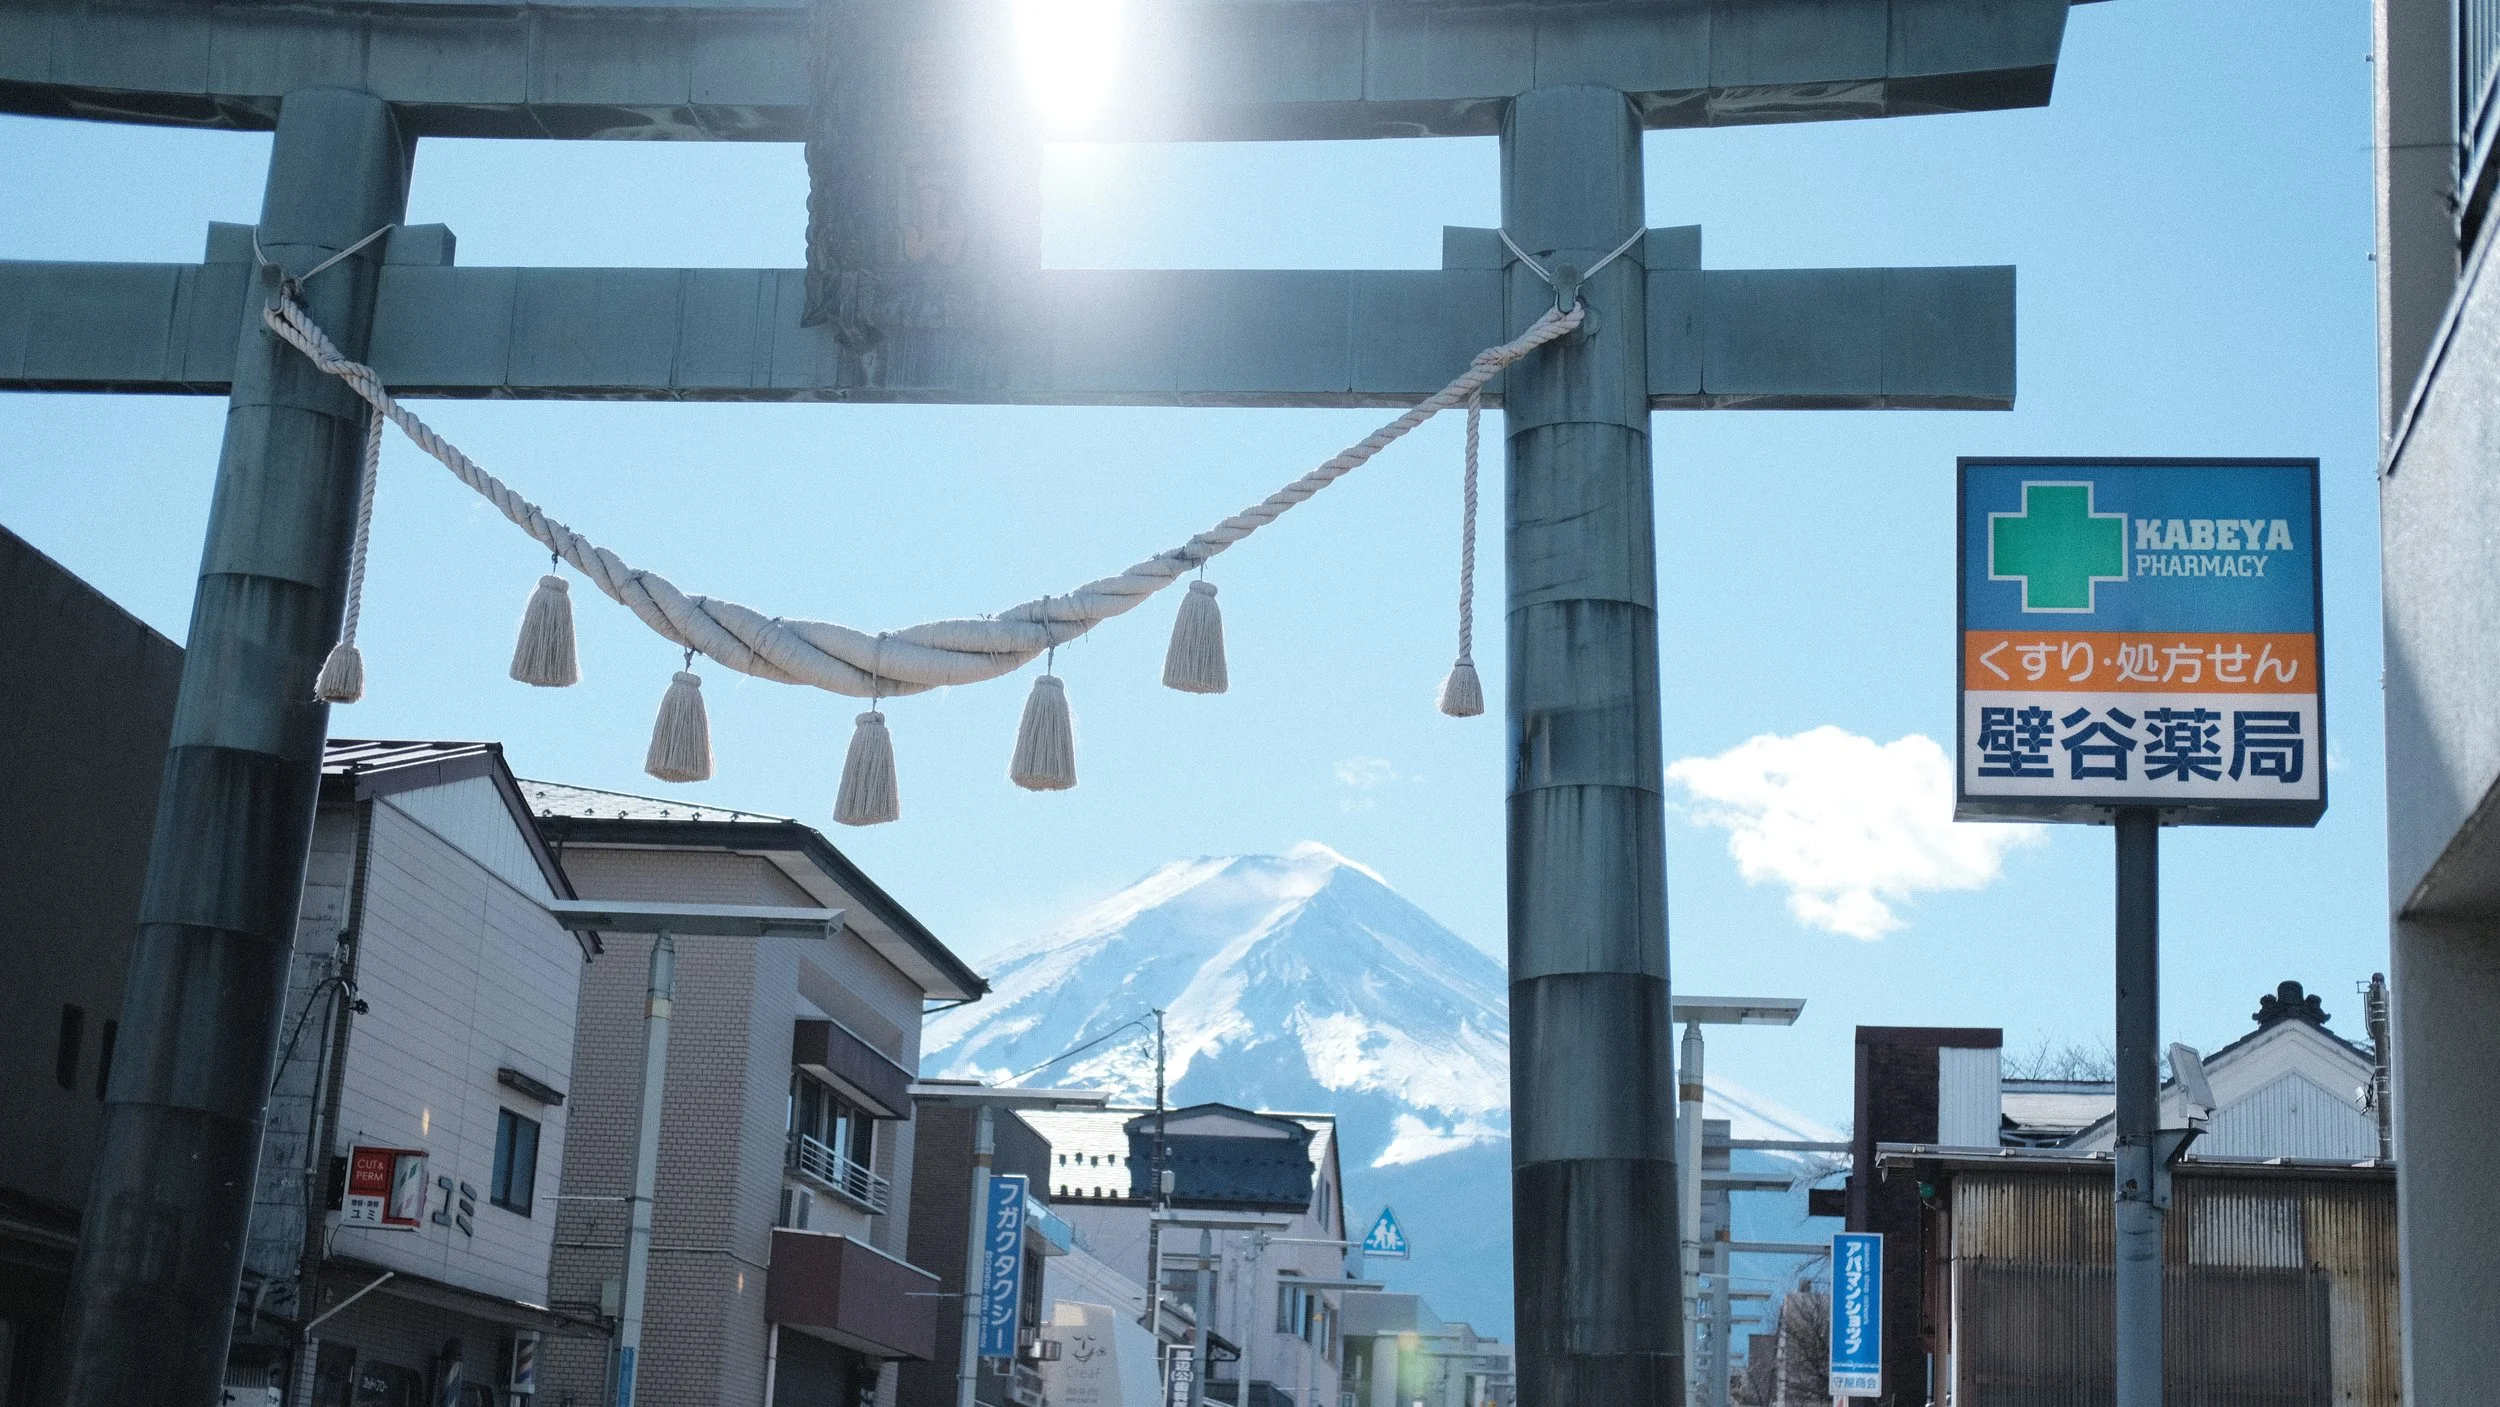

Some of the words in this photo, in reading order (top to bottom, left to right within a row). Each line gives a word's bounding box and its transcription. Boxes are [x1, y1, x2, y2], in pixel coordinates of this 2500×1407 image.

[2135, 518, 2294, 551] KABEYA
[2136, 554, 2269, 578] PHARMACY
[1979, 640, 2298, 684] くすり・処方せん
[1977, 705, 2305, 784] 壁谷薬局
[355, 1171, 384, 1182] PERM
[357, 1159, 385, 1170] CUT&
[431, 1174, 478, 1238] ユミ
[991, 1183, 1019, 1349] フガクタクシー
